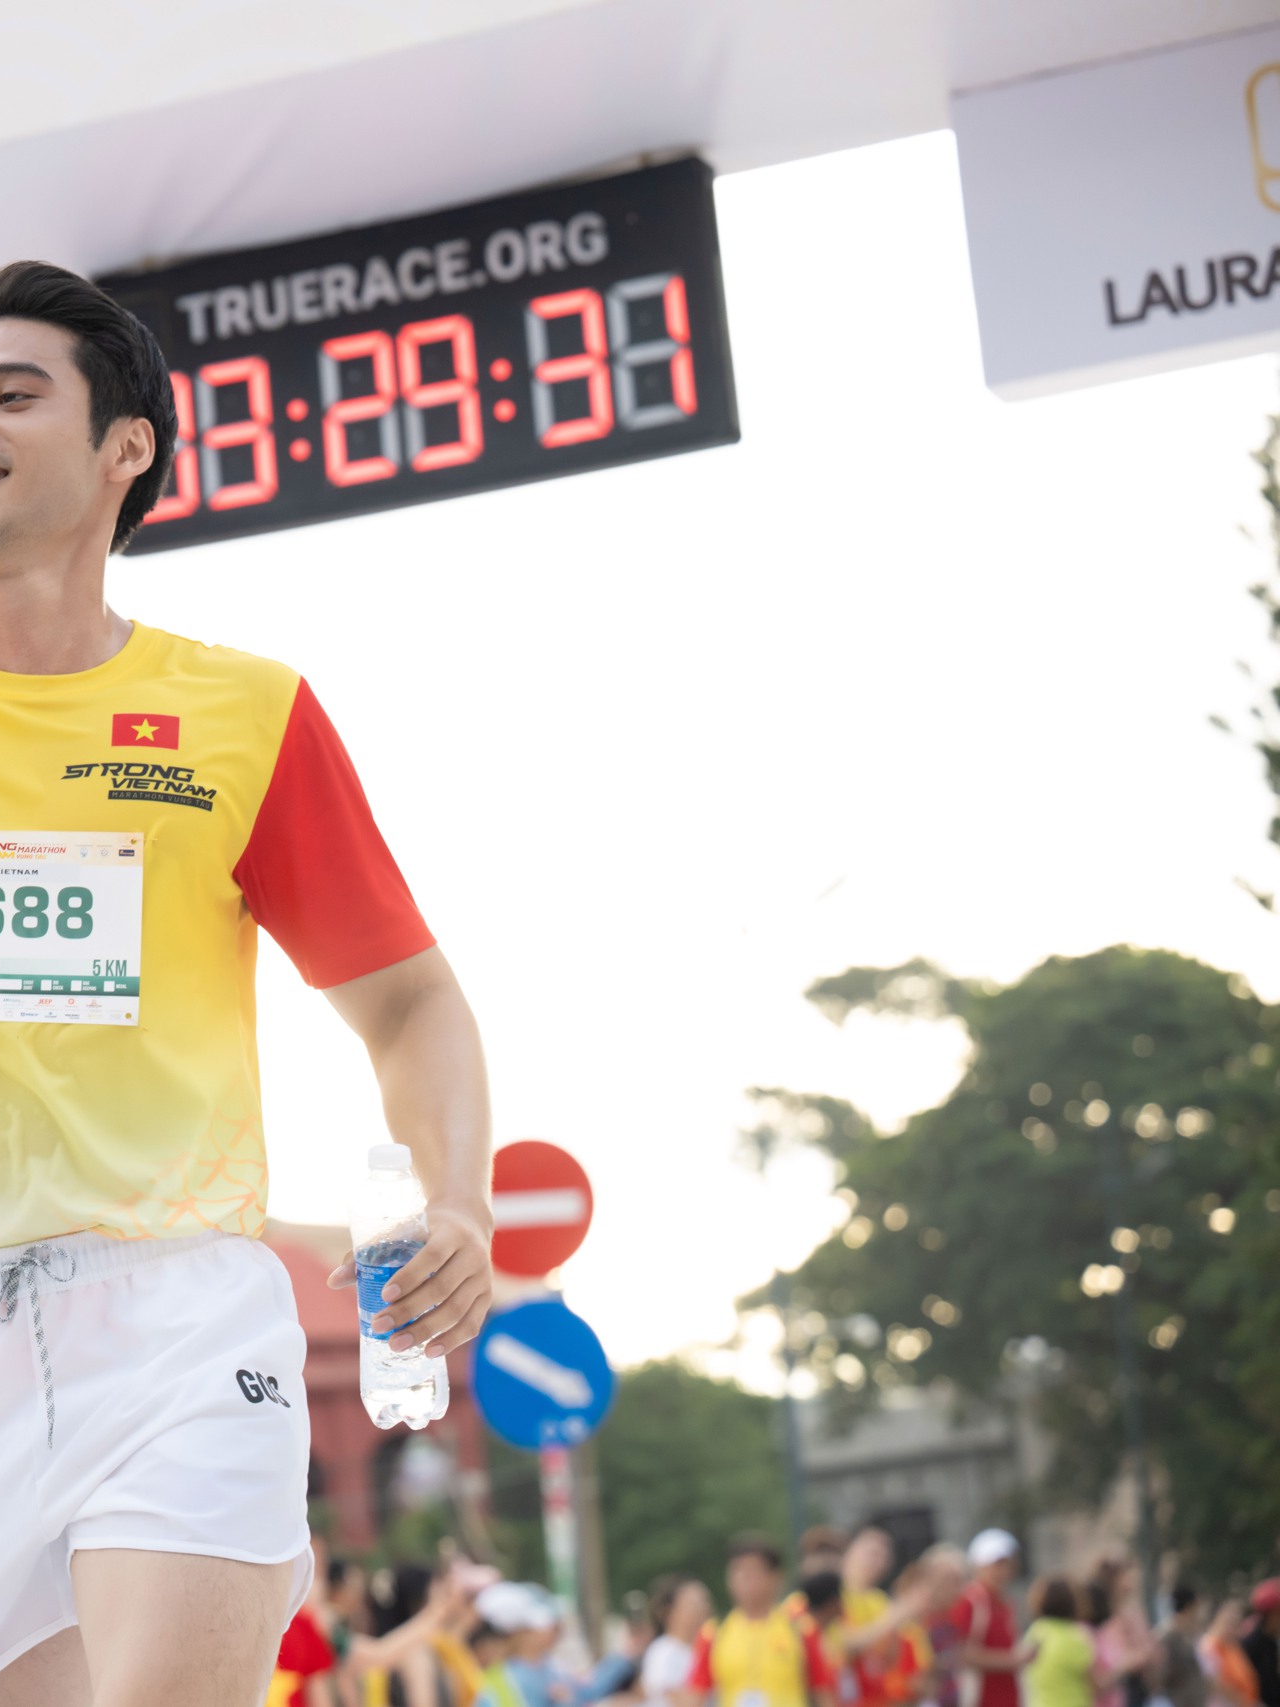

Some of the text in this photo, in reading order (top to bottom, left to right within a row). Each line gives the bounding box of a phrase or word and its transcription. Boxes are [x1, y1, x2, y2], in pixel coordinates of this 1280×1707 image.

[175, 212, 608, 344] TRUERACE.ORG
[61, 762, 195, 782] STRONG
[111, 777, 217, 800] VIETNAM
[111, 791, 211, 810] MARATHON VUNG TAU
[17, 846, 67, 854] MARATHON
[92, 959, 127, 977] 5 KM
